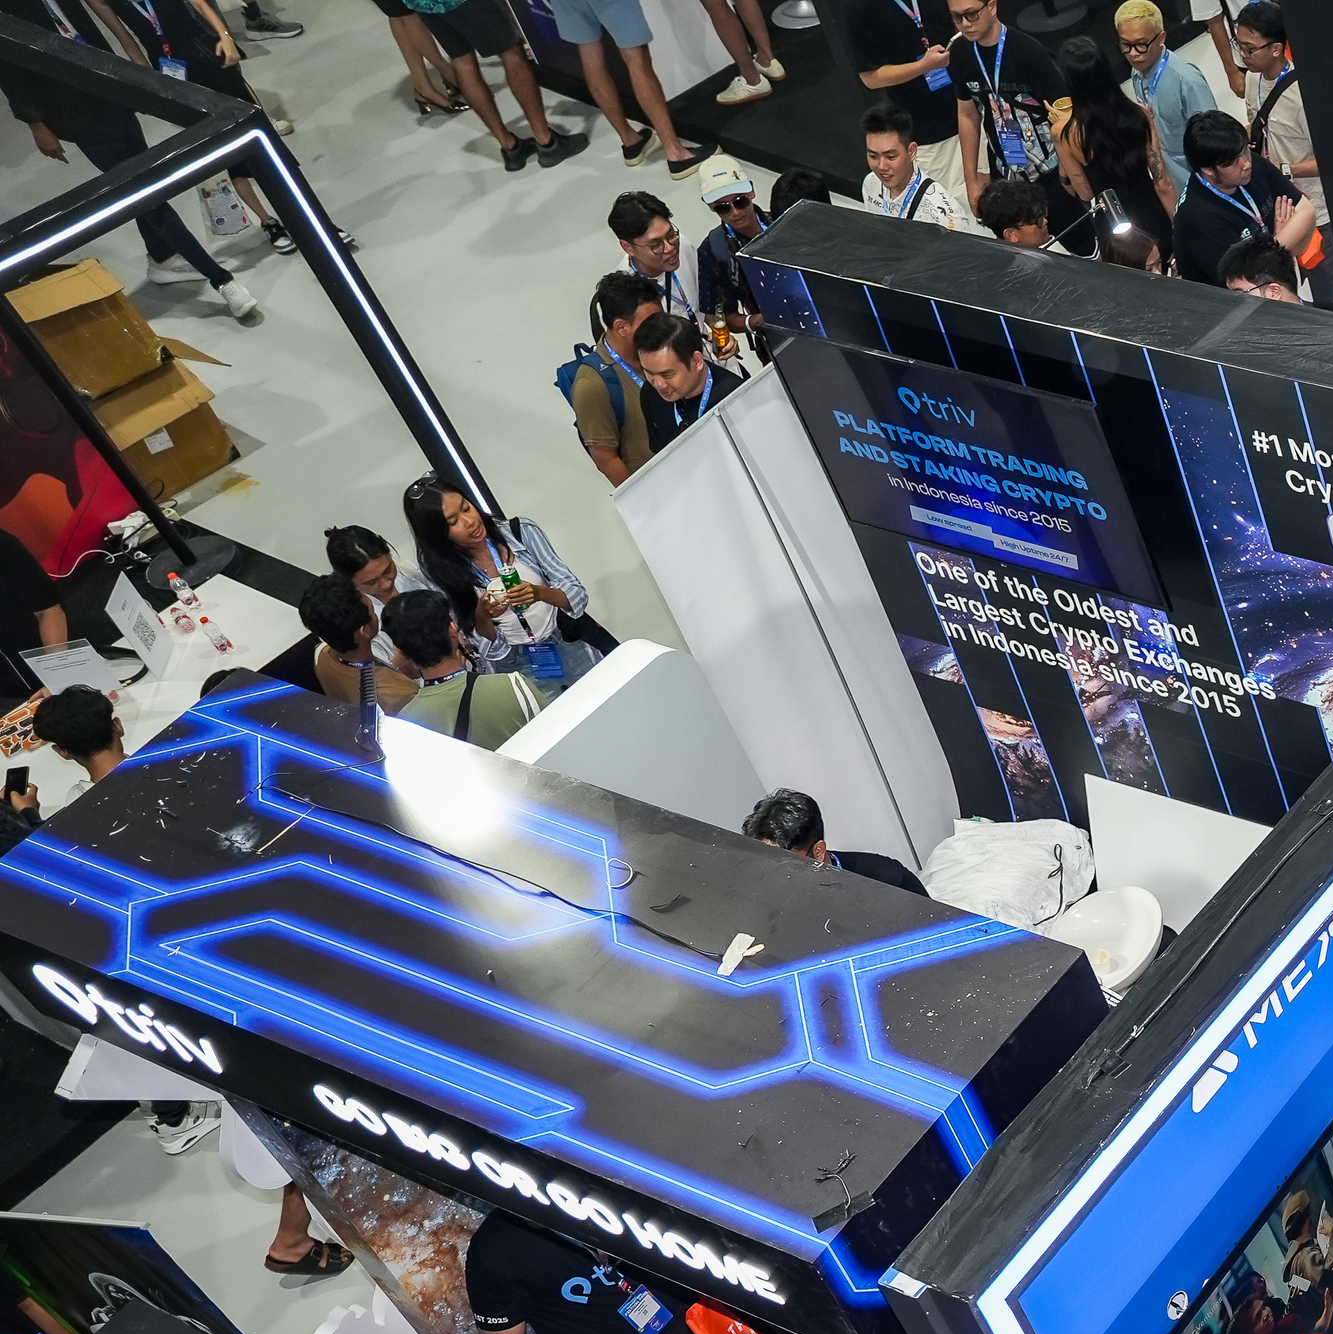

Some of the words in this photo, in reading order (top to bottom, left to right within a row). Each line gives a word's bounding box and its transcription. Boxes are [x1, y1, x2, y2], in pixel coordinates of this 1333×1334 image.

[832, 409, 971, 460] PLATFORM
[971, 447, 1088, 490] TRADING
[922, 392, 975, 428] triv
[1252, 430, 1282, 457] #1
[839, 437, 890, 464] AND
[893, 451, 999, 493] STAKING
[1002, 480, 1108, 521] CRYPTO
[888, 473, 903, 489] in
[903, 476, 982, 510] Indonesia
[984, 500, 1029, 522] since
[1030, 511, 1072, 533] 2015
[1000, 539, 1018, 550] High
[1018, 543, 1046, 559] Uptime
[1046, 551, 1069, 563] 24/7
[915, 551, 969, 584] One
[973, 569, 1000, 593] of
[1003, 575, 1050, 606] the
[1053, 589, 1143, 632] Oldest
[1150, 616, 1200, 647] and
[928, 583, 1026, 631] Largest
[1032, 611, 1118, 655] Crypto
[1124, 639, 1277, 700] Exchanges
[942, 615, 968, 640] in
[972, 626, 1094, 677] Indonesia
[1098, 661, 1169, 698] since
[1171, 681, 1242, 719] 2015
[312, 1083, 388, 1135] GO
[474, 1148, 550, 1206] OR
[549, 1182, 625, 1236] GO
[619, 1211, 787, 1306] HOME
